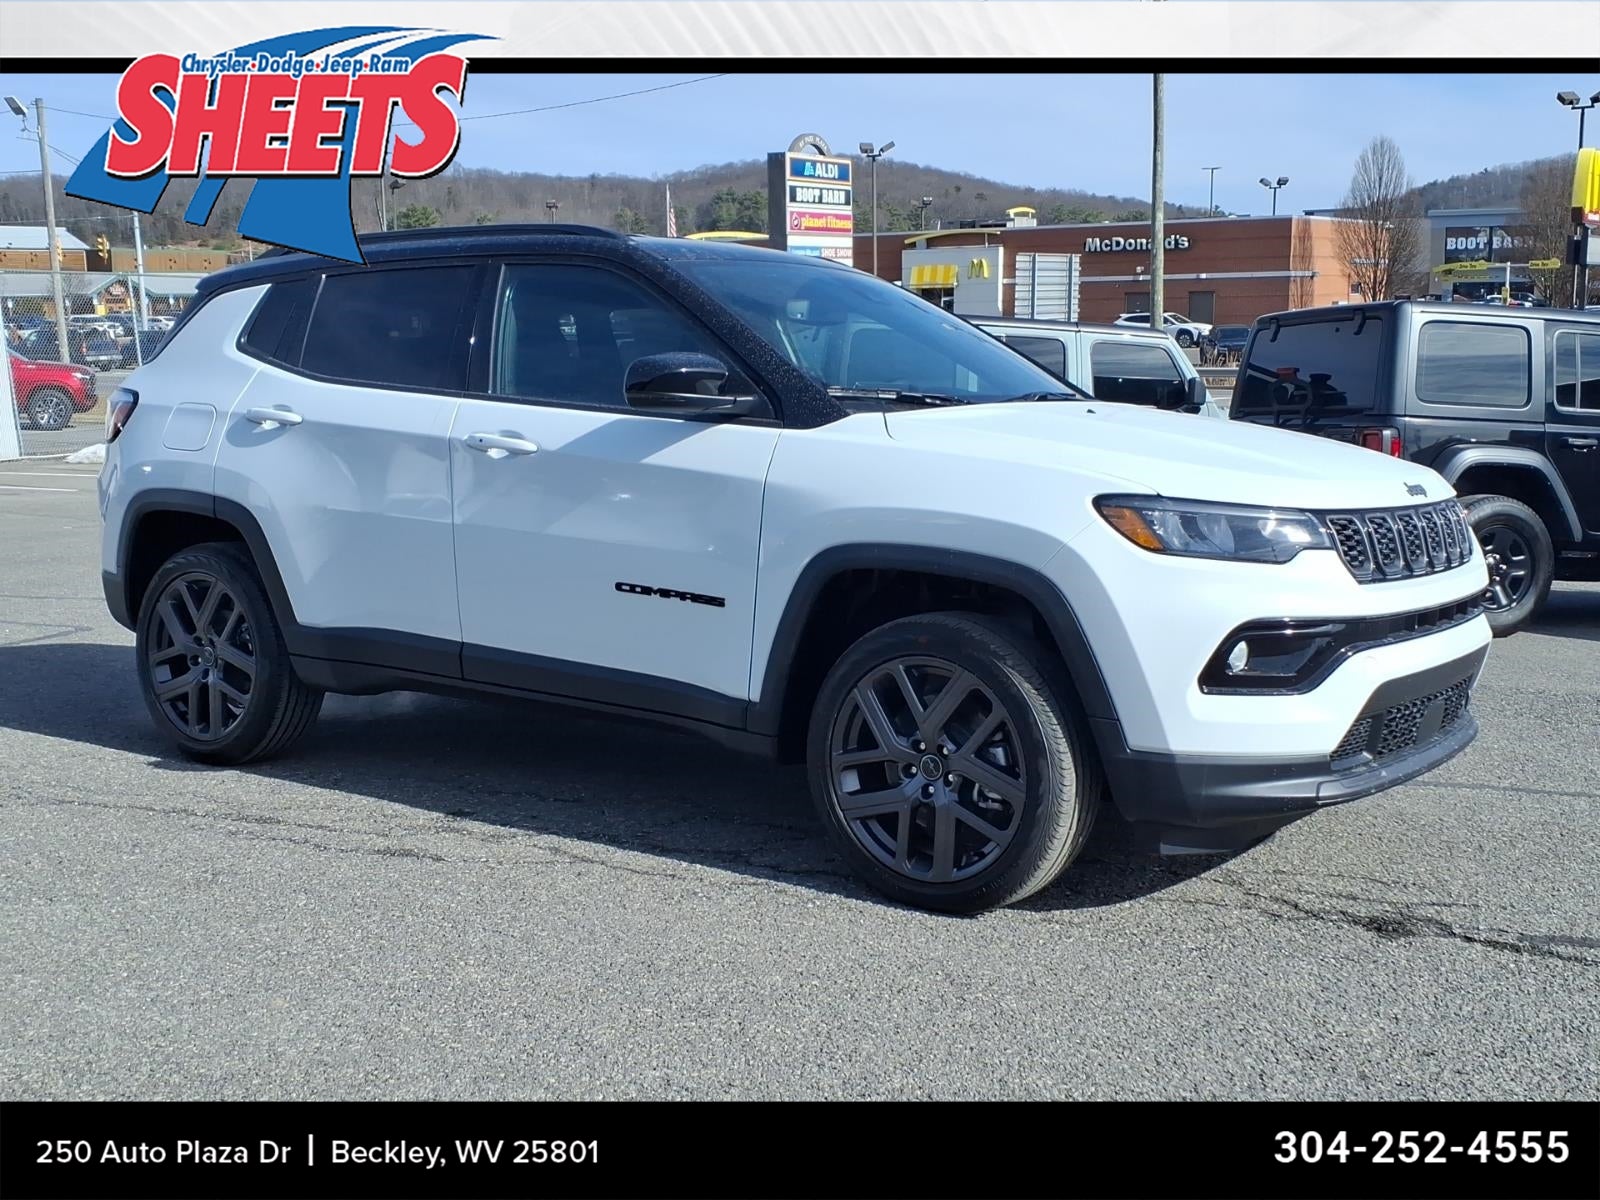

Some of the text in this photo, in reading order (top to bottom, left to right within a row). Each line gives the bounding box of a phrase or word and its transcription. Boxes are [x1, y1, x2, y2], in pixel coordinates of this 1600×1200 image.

[814, 163, 838, 179] ALDI
[796, 187, 846, 204] BOOT BARN
[800, 214, 851, 230] planet fitness
[1085, 235, 1189, 252] McDond's
[1446, 237, 1487, 250] BOOT
[821, 247, 836, 258] SHOE
[614, 581, 726, 608] COMPASS
